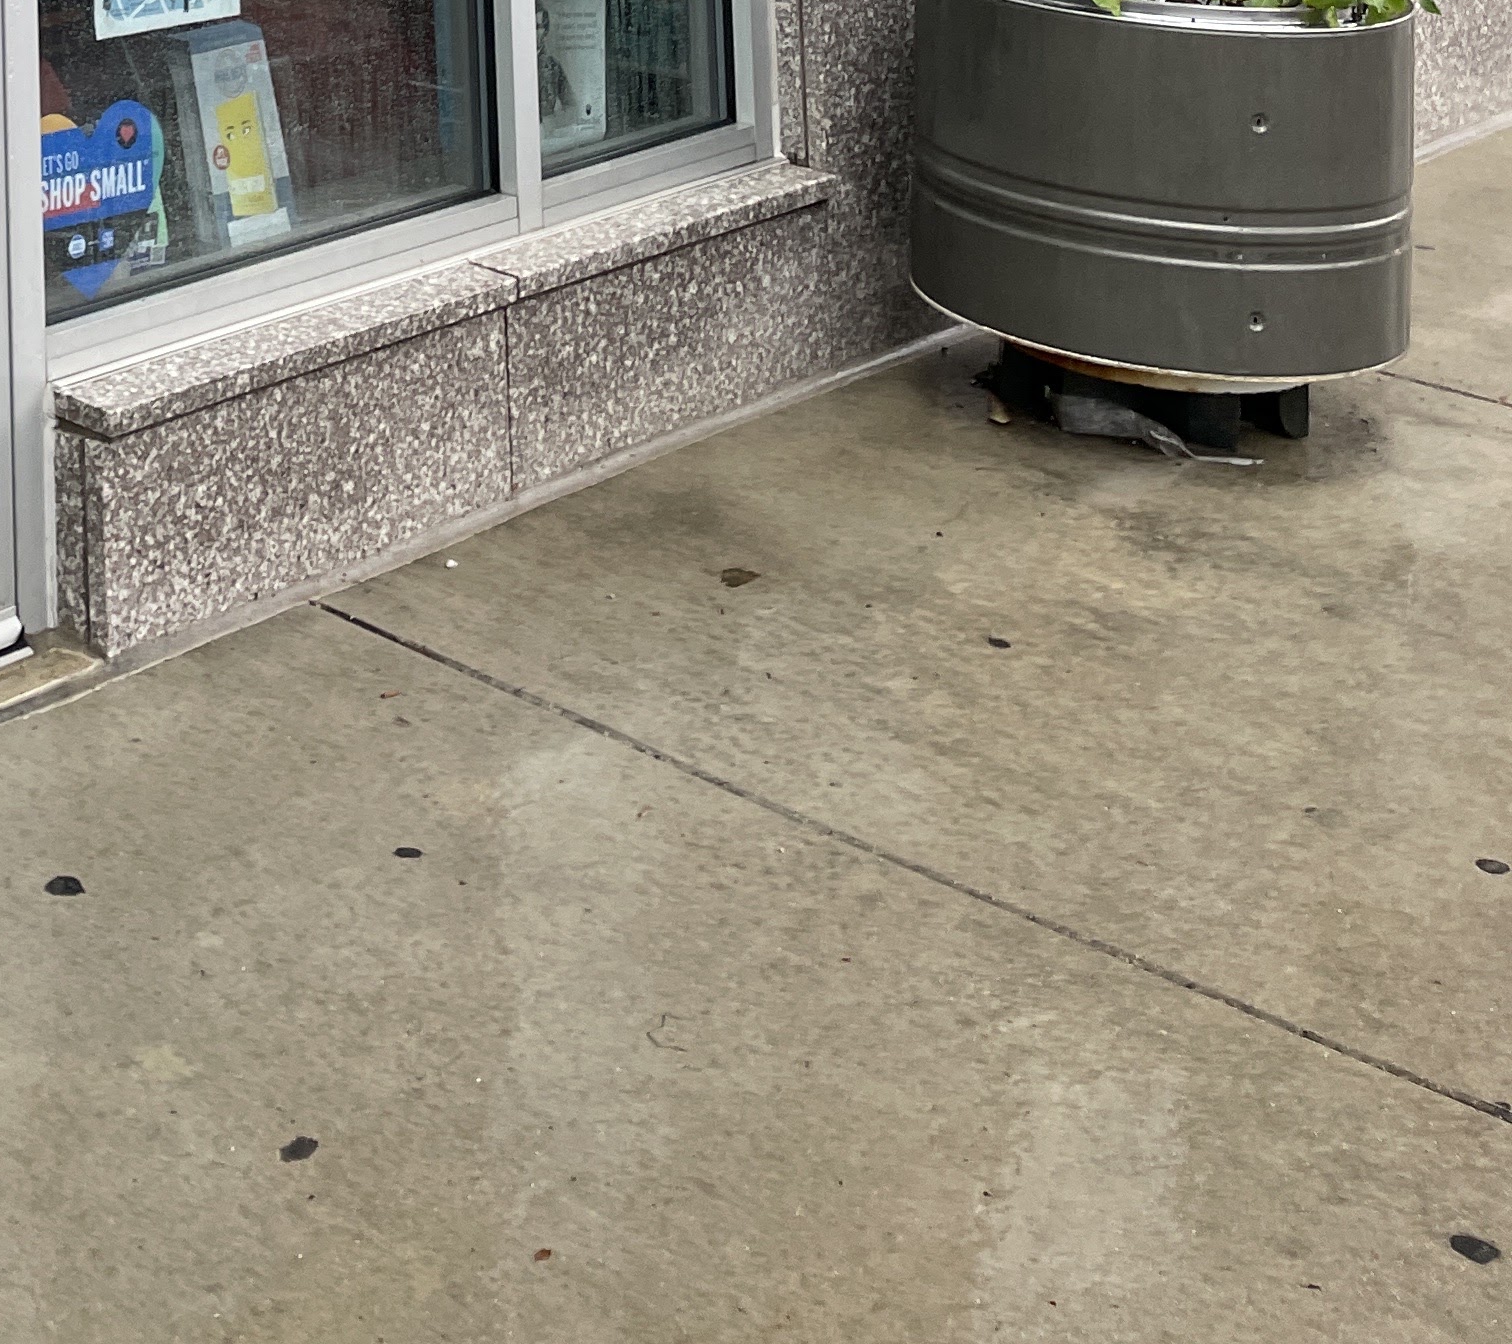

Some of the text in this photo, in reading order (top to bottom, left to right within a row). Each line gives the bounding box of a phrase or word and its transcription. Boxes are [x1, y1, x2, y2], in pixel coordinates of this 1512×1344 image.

[41, 149, 79, 177] ET'S GO
[41, 160, 146, 213] SHOP SMALL
